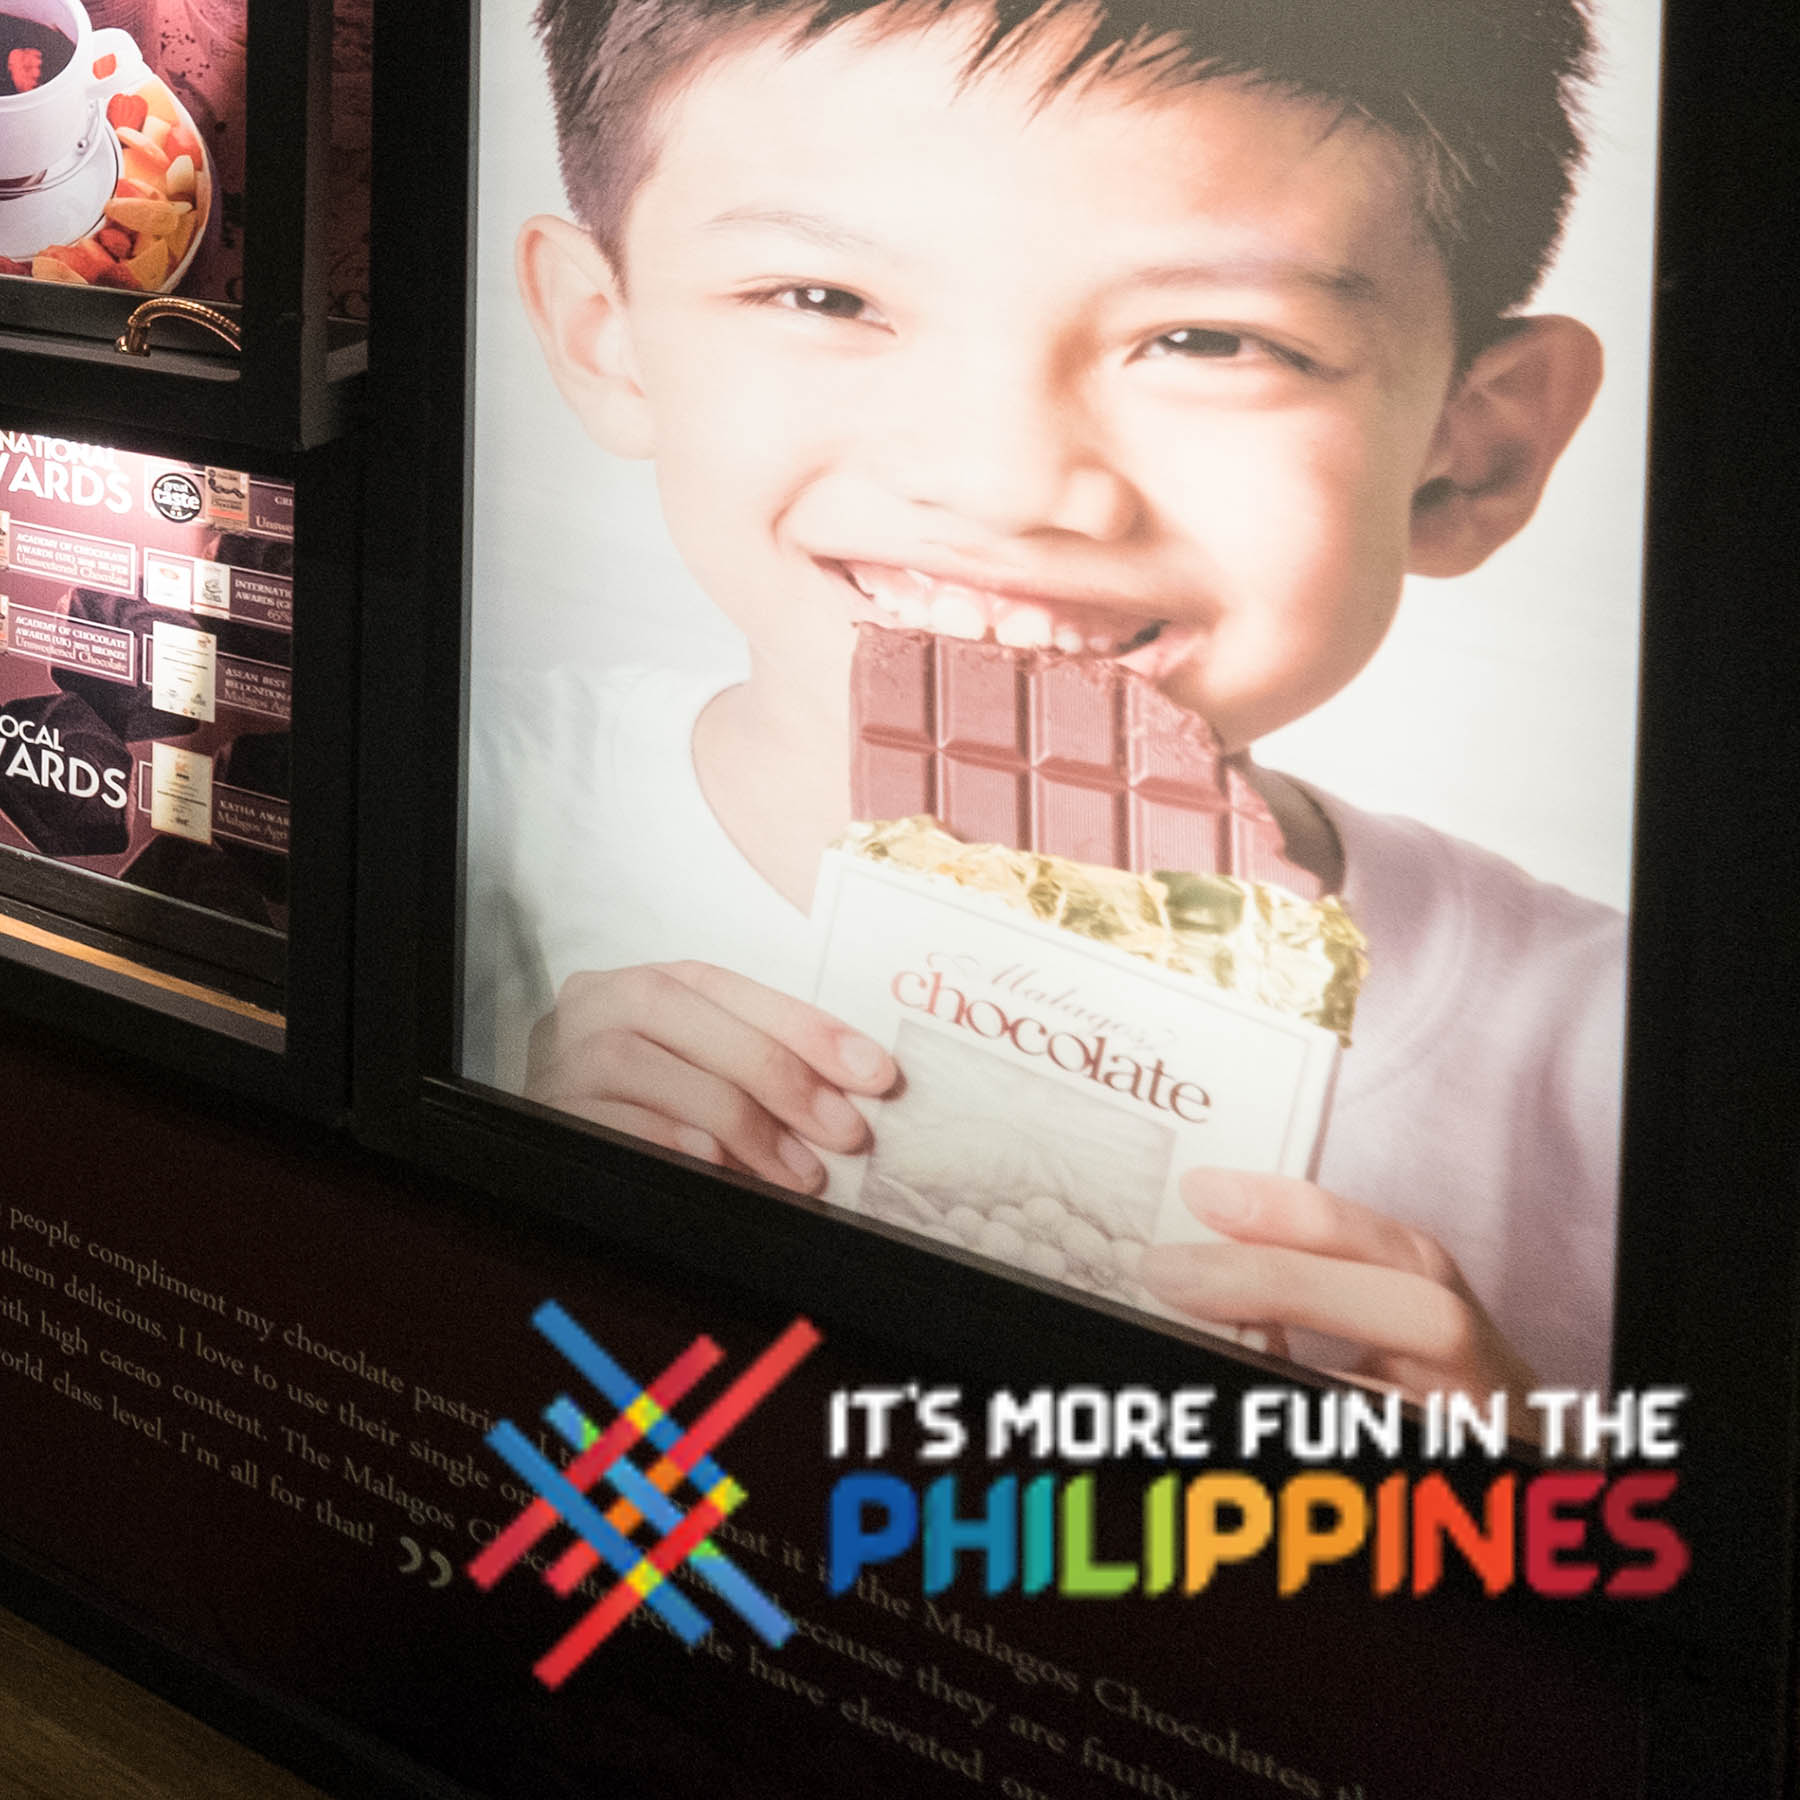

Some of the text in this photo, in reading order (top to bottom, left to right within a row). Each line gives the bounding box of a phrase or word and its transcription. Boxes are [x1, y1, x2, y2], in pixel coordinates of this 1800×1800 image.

[153, 488, 201, 510] taste
[16, 616, 127, 650] ACADEMY OF CHOCOLATE
[78, 650, 127, 673] Chocolate
[890, 965, 1212, 1126] chocolate
[1, 1247, 56, 1290] them
[63, 1274, 168, 1342] delicious.
[177, 1326, 187, 1351] I
[195, 1331, 245, 1376] love
[252, 1360, 279, 1393] to
[287, 1383, 330, 1415] use
[337, 1400, 401, 1448] their
[408, 1438, 490, 1488] single
[916, 1665, 995, 1727] they
[1008, 1713, 1067, 1753] are
[8, 1207, 81, 1250] people
[87, 1241, 227, 1317] compliment
[235, 1304, 277, 1342] my
[283, 1321, 405, 1393] chocolate
[856, 1572, 912, 1618] the
[924, 1598, 1080, 1693] Malagos
[1094, 1677, 1321, 1798] Chocolates
[52, 1371, 103, 1413] class
[112, 1395, 169, 1445] level.
[180, 1431, 221, 1471] I'm
[230, 1461, 259, 1492] all
[270, 1474, 306, 1512] for
[316, 1499, 375, 1547] that!
[39, 1310, 89, 1357] high
[100, 1349, 161, 1389] cacao
[171, 1379, 268, 1441] content.
[280, 1425, 331, 1470] The
[343, 1455, 455, 1530] Malagos
[750, 1645, 825, 1706] have
[840, 1696, 984, 1782] elevated
